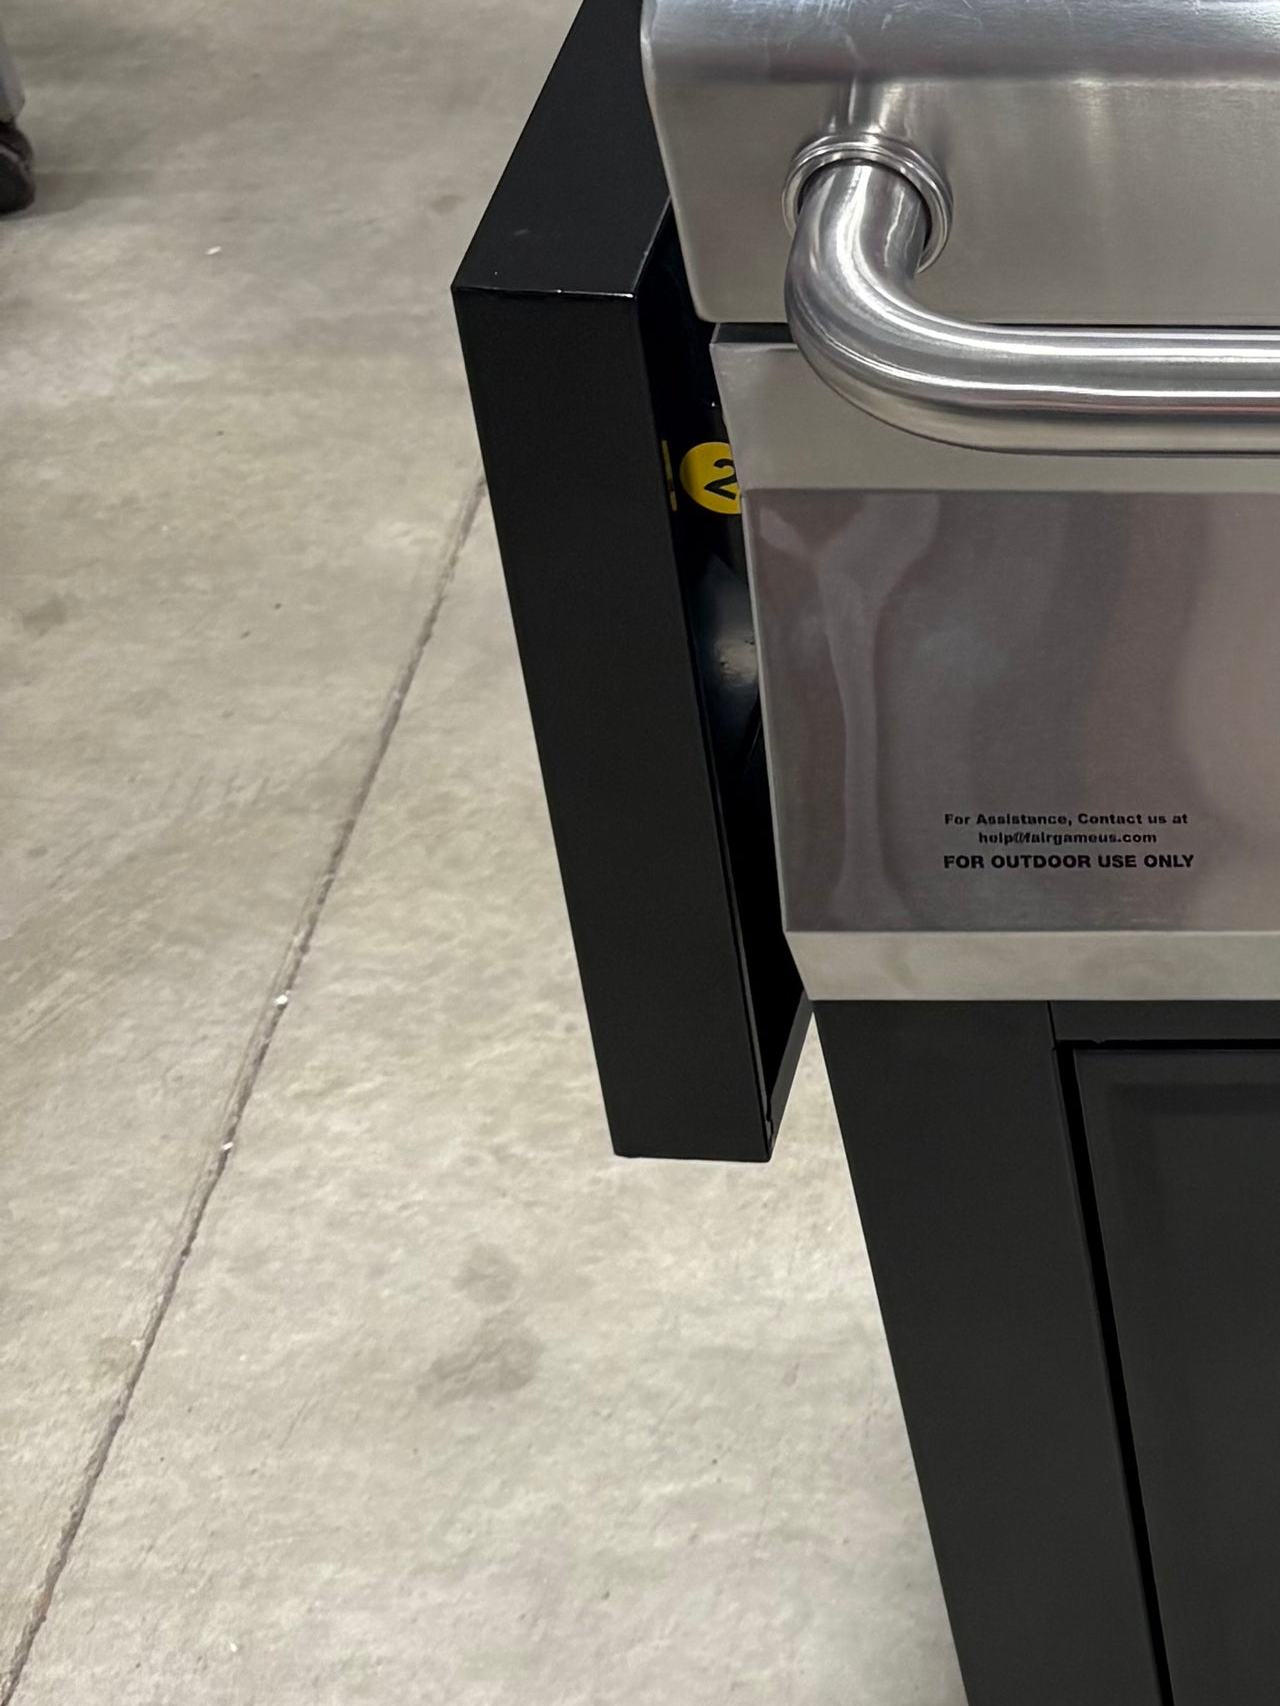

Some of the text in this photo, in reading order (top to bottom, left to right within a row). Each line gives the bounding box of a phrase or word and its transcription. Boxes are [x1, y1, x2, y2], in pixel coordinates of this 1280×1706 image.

[944, 813, 1189, 827] For Assistance, Contact us at
[978, 831, 1158, 846] help@fairgameus.com
[943, 853, 1195, 869] FOR OUTDOOR USE ONLY
